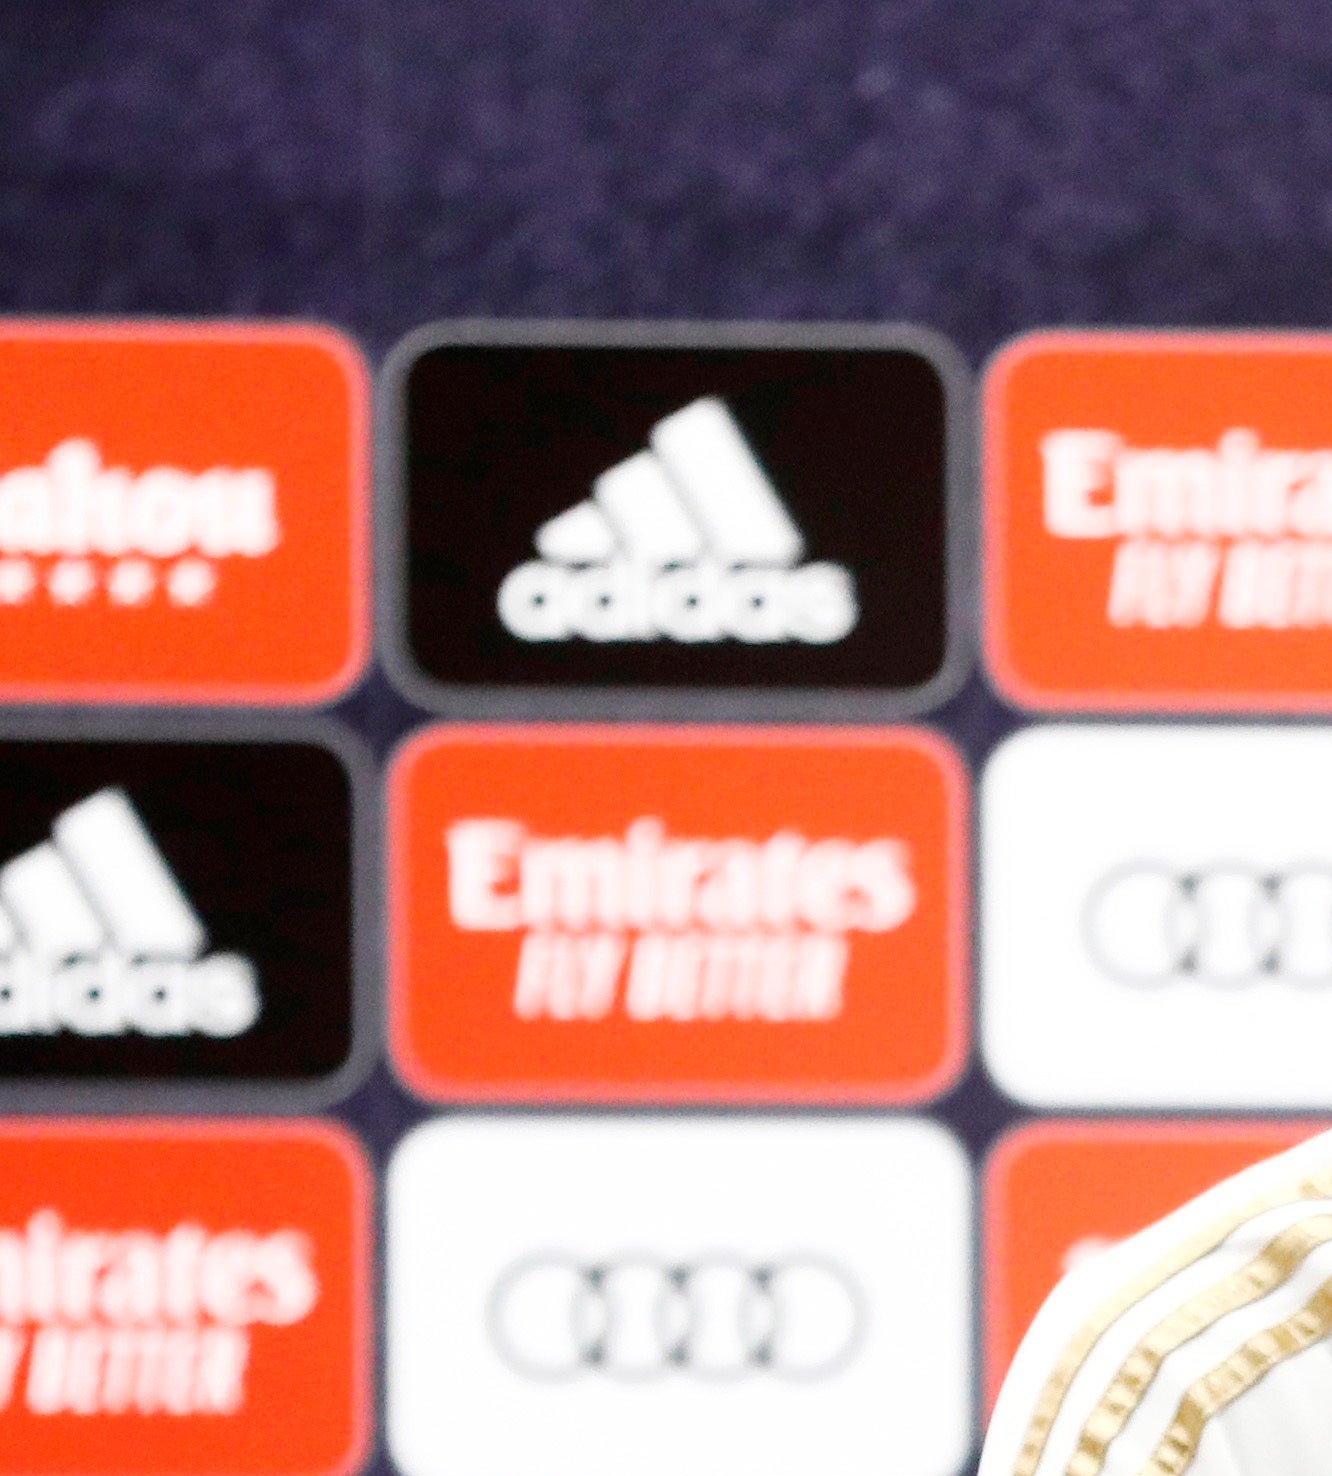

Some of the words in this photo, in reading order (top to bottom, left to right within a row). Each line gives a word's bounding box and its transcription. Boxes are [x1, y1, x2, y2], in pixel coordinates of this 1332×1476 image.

[497, 562, 858, 644] adidas
[446, 818, 916, 933] Emirates
[0, 1211, 318, 1328] irates
